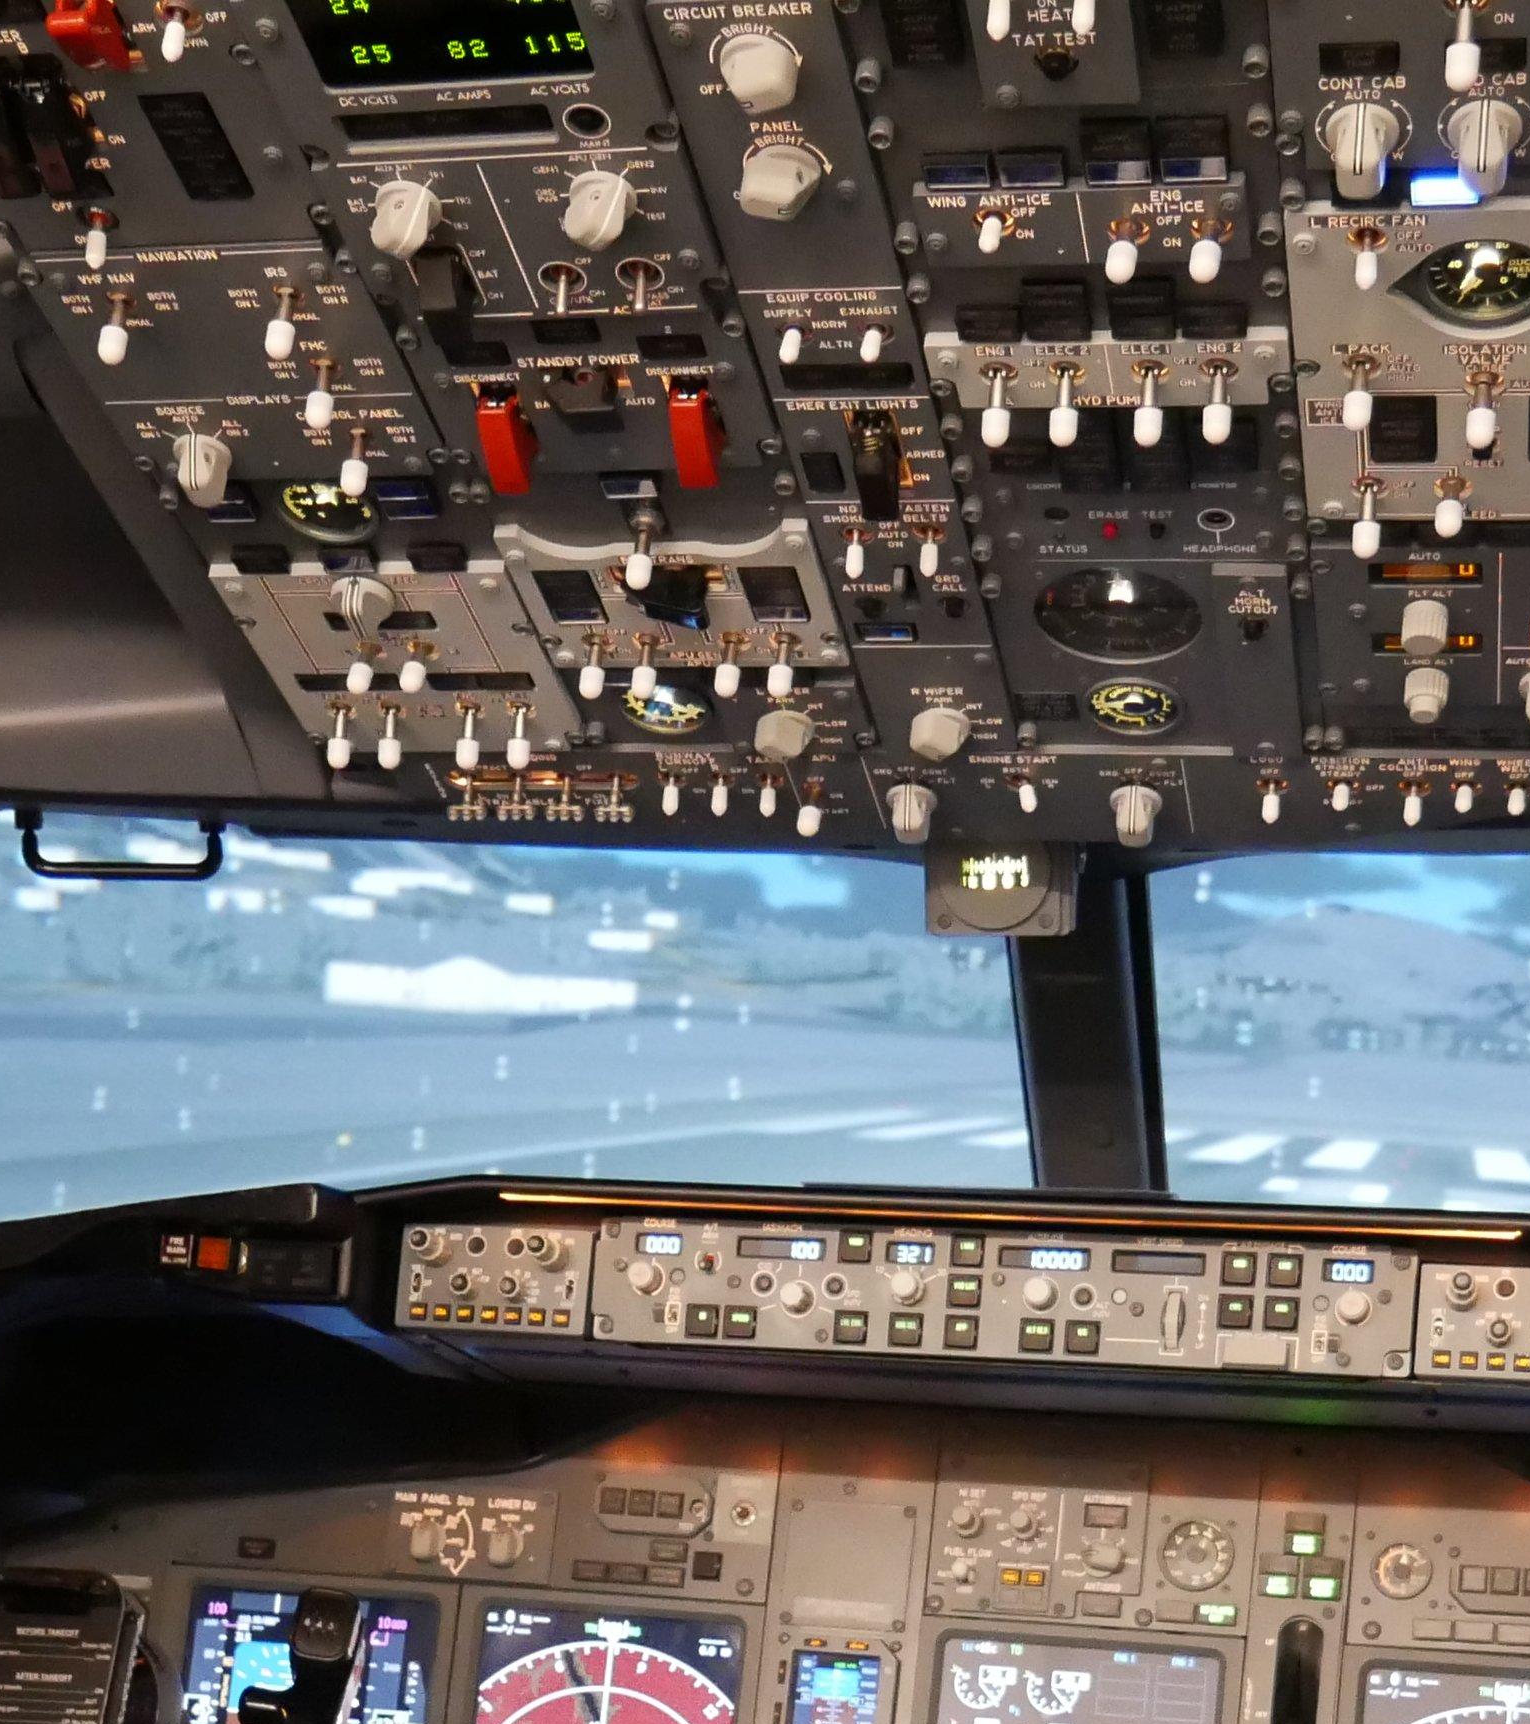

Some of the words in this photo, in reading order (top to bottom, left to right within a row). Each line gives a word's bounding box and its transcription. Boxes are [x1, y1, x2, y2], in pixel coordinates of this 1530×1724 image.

[664, 7, 727, 20] CIRCUIT
[732, 2, 812, 17] BREAKER
[205, 12, 228, 23] OFF
[1493, 13, 1515, 24] ON
[721, 23, 775, 38] BRIGHT
[1012, 32, 1049, 47] TAT
[1053, 31, 1098, 46] TEST
[351, 45, 391, 64] 25
[525, 32, 586, 54] 115
[1318, 77, 1364, 90] CONT
[1370, 76, 1407, 90] CAB
[1491, 72, 1528, 86] CAB
[530, 86, 549, 96] AC
[551, 82, 590, 95] VOLTS
[699, 83, 724, 96] OFF
[1344, 90, 1381, 100] AUTO
[1468, 86, 1506, 97] AUTO
[339, 97, 358, 107] DC
[360, 94, 398, 105] VOLTS
[436, 92, 455, 102] AC
[458, 89, 491, 100] AMPS
[749, 120, 803, 135] PANEL
[926, 196, 967, 208] WING
[979, 194, 1051, 206] ANTI-ICE
[1149, 190, 1182, 201] ENG
[1010, 207, 1036, 218] OFF
[1131, 200, 1205, 214] ANTI-ICE
[1156, 216, 1182, 226] OFF
[1162, 237, 1182, 248] ON
[135, 249, 219, 263] NAVIGATION
[77, 274, 103, 286] VHF
[106, 272, 136, 285] NAV
[766, 292, 810, 305] EQUIP
[814, 291, 878, 304] COOLING
[763, 308, 813, 320] SUPPLY
[839, 305, 899, 318] EXHAUST
[811, 319, 848, 331] NORM
[299, 340, 328, 352] FMC
[819, 339, 853, 351] ALTN
[1442, 344, 1528, 356] ISOLATION
[517, 355, 582, 368] STANDBY
[585, 353, 640, 367] POWER
[1458, 354, 1511, 366] VALVE
[645, 364, 715, 377] DISCONNECT
[454, 372, 521, 385] DISCONNECT
[225, 394, 292, 406] DISPLAYS
[786, 400, 825, 413] EMER
[829, 399, 861, 412] EXIT
[865, 398, 919, 411] LIGHTS
[154, 406, 205, 416] SOURCE
[906, 450, 945, 459] ARMED
[1088, 510, 1130, 519] ERASE
[1141, 510, 1172, 519] TEST
[1038, 544, 1088, 554] STATUS
[1182, 544, 1257, 554] HEADPHONE
[1408, 552, 1441, 562] AUTO
[841, 582, 892, 593] ATTEND
[932, 583, 967, 592] CALL
[1238, 589, 1264, 598] ALT
[1233, 597, 1272, 606] HORN
[1228, 605, 1279, 614] CUTOUT
[910, 687, 920, 696] R
[923, 686, 964, 696] WIPER
[968, 755, 1015, 764] ENGINE
[1019, 755, 1057, 764] START
[1396, 758, 1429, 767] ANTI
[1449, 758, 1481, 767] WING
[1378, 763, 1448, 772] COLLISION
[645, 1237, 678, 1255] 000
[895, 1247, 932, 1265] 321
[1331, 1262, 1369, 1282] 000
[395, 1491, 419, 1503] MAIN
[421, 1493, 452, 1505] PANEL
